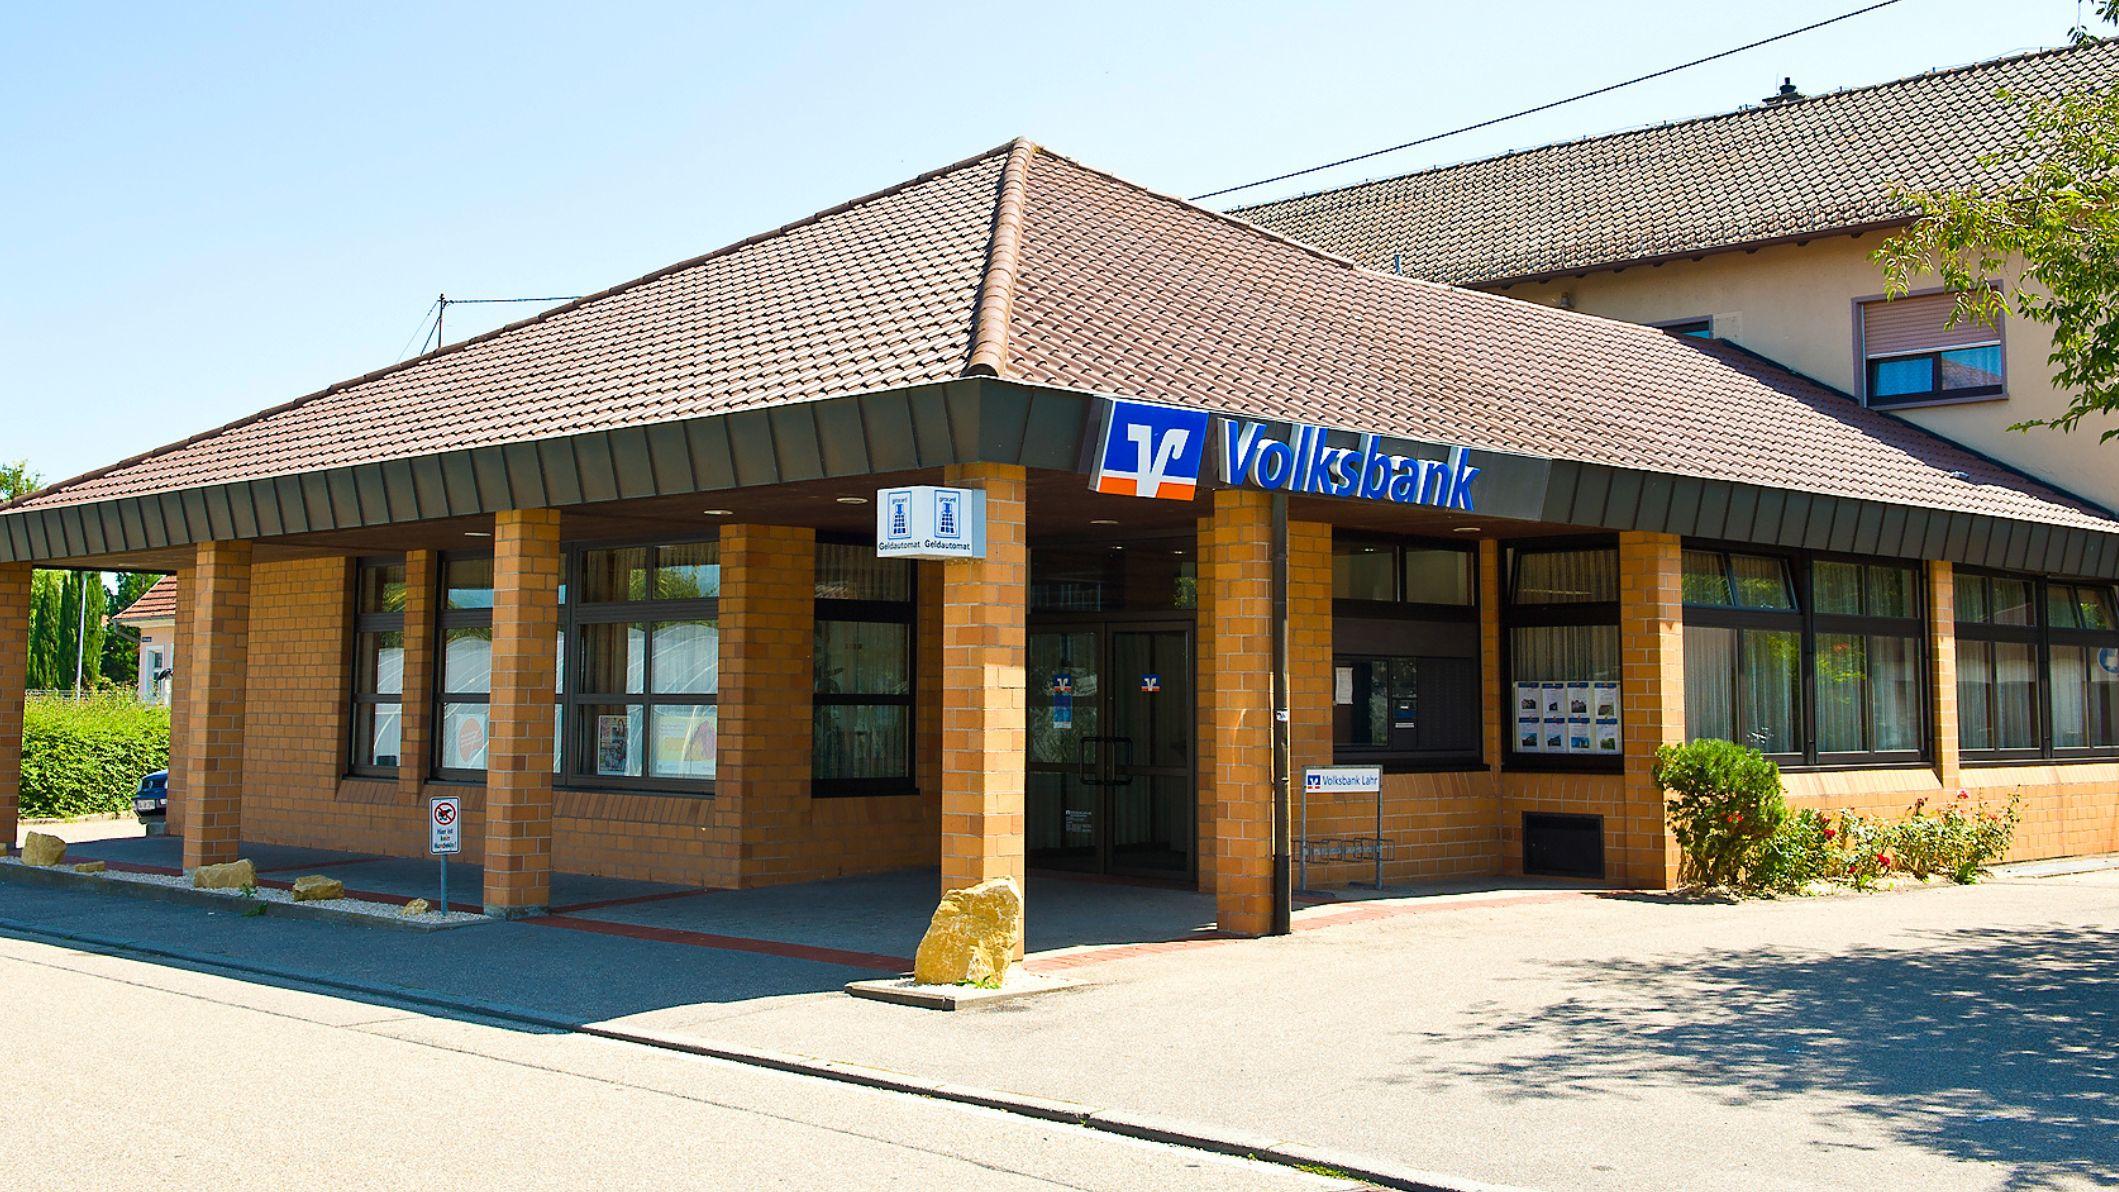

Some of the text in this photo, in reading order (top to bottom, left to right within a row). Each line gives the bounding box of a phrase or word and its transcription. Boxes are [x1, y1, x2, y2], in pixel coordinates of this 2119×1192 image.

[1219, 418, 1481, 511] Volksbank
[879, 541, 920, 551] Geldautomat
[924, 539, 970, 550] Geldautomat
[1323, 775, 1378, 786] Volksbank Lahr
